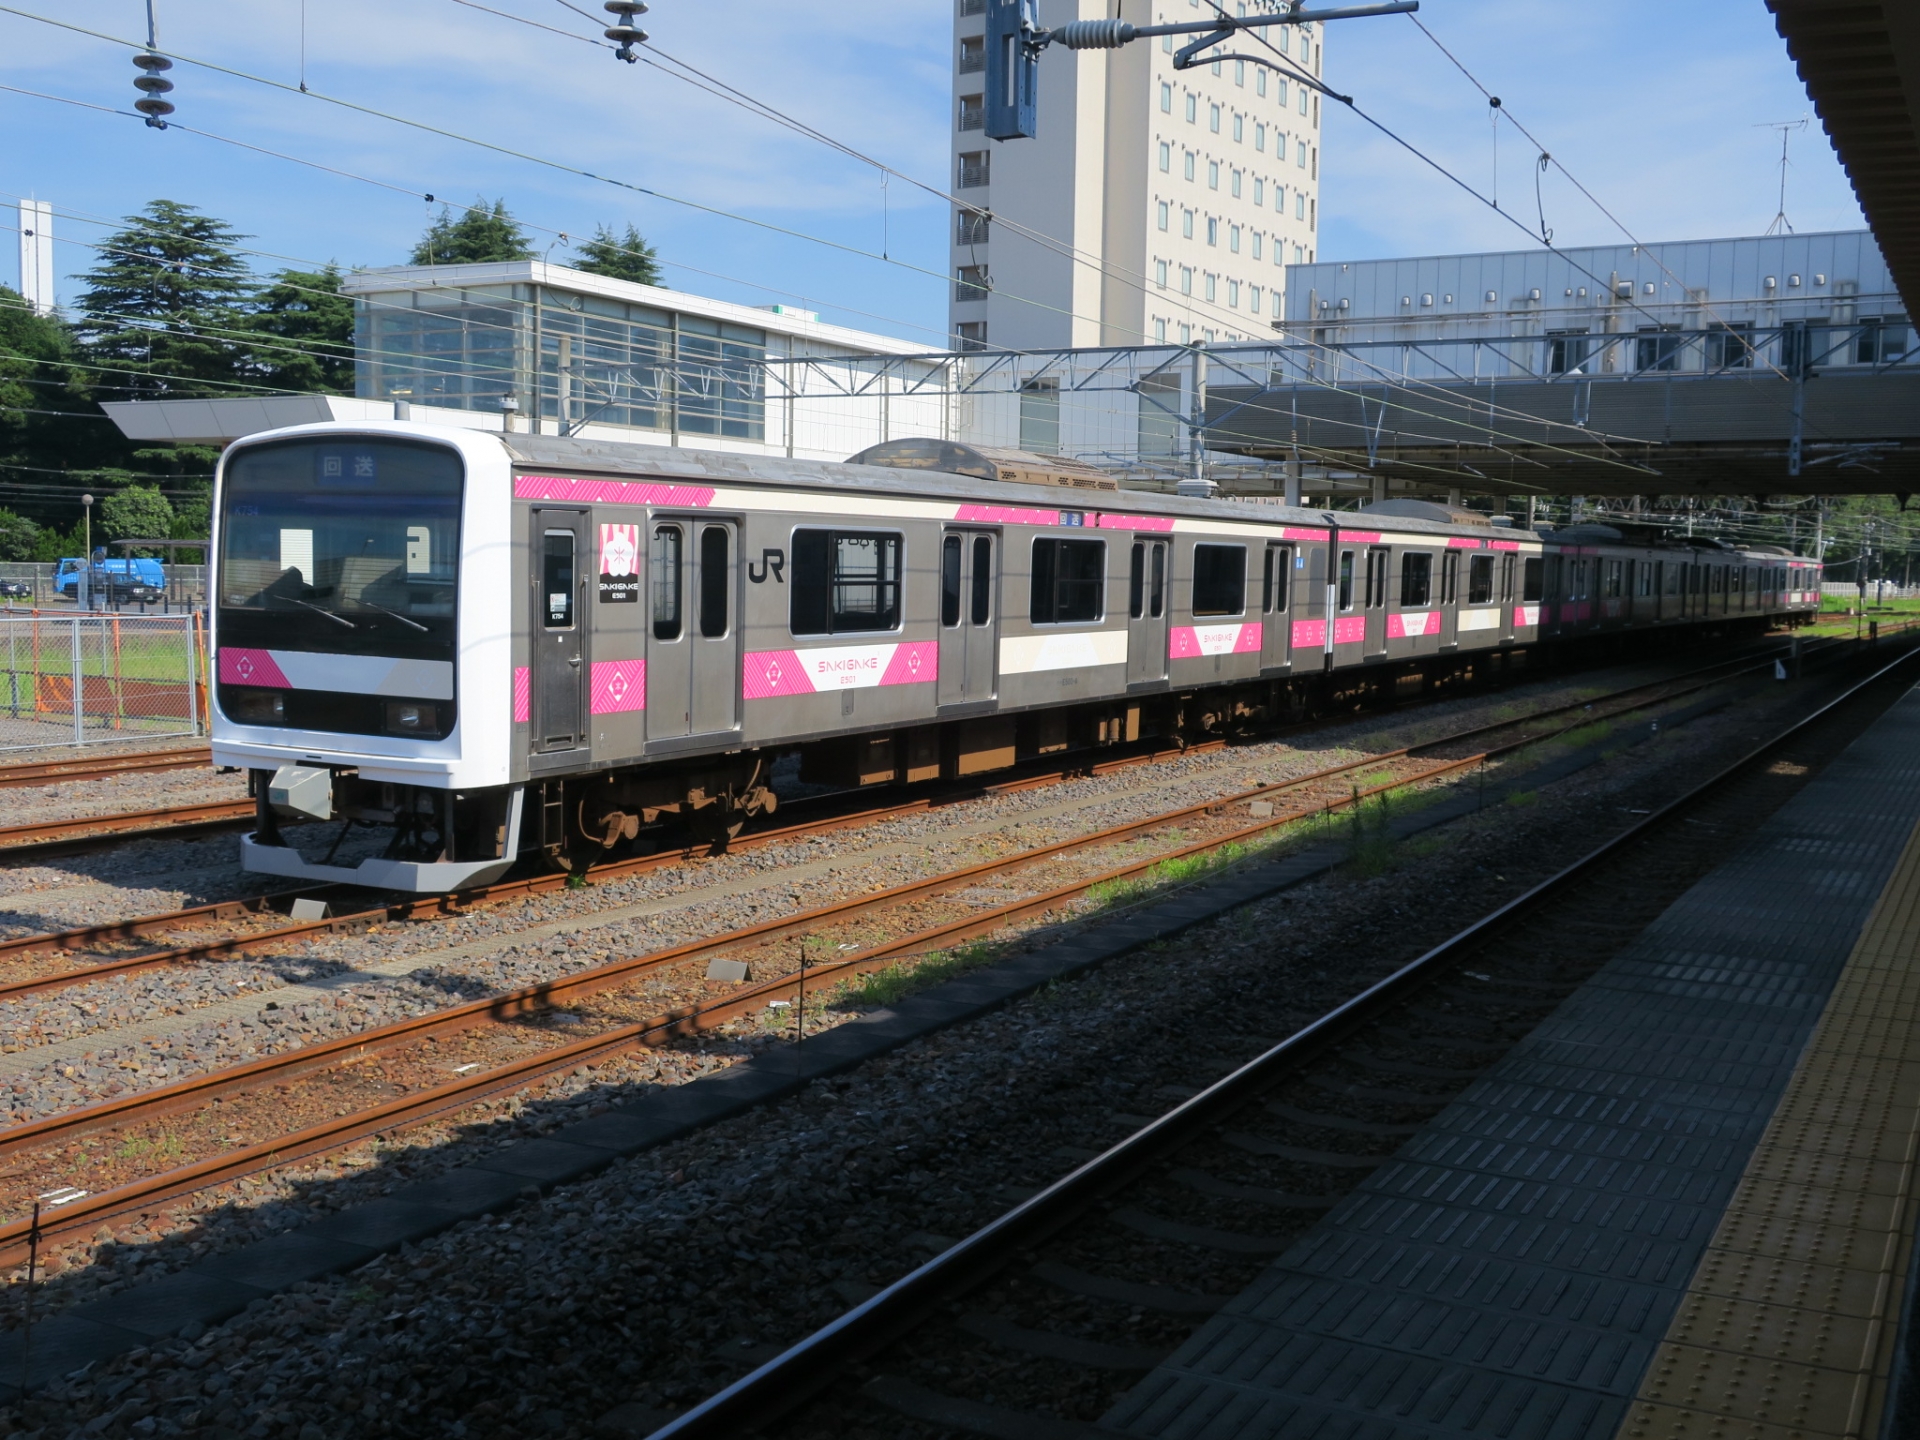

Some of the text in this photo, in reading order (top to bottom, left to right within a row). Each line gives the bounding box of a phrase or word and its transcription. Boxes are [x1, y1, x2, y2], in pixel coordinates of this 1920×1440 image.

[324, 455, 373, 477] 回送
[235, 505, 259, 516] K754
[749, 548, 784, 584] JR
[599, 583, 638, 591] SAKIGAKE
[818, 657, 878, 673] SAKIGAKE
[840, 676, 856, 684] E501
